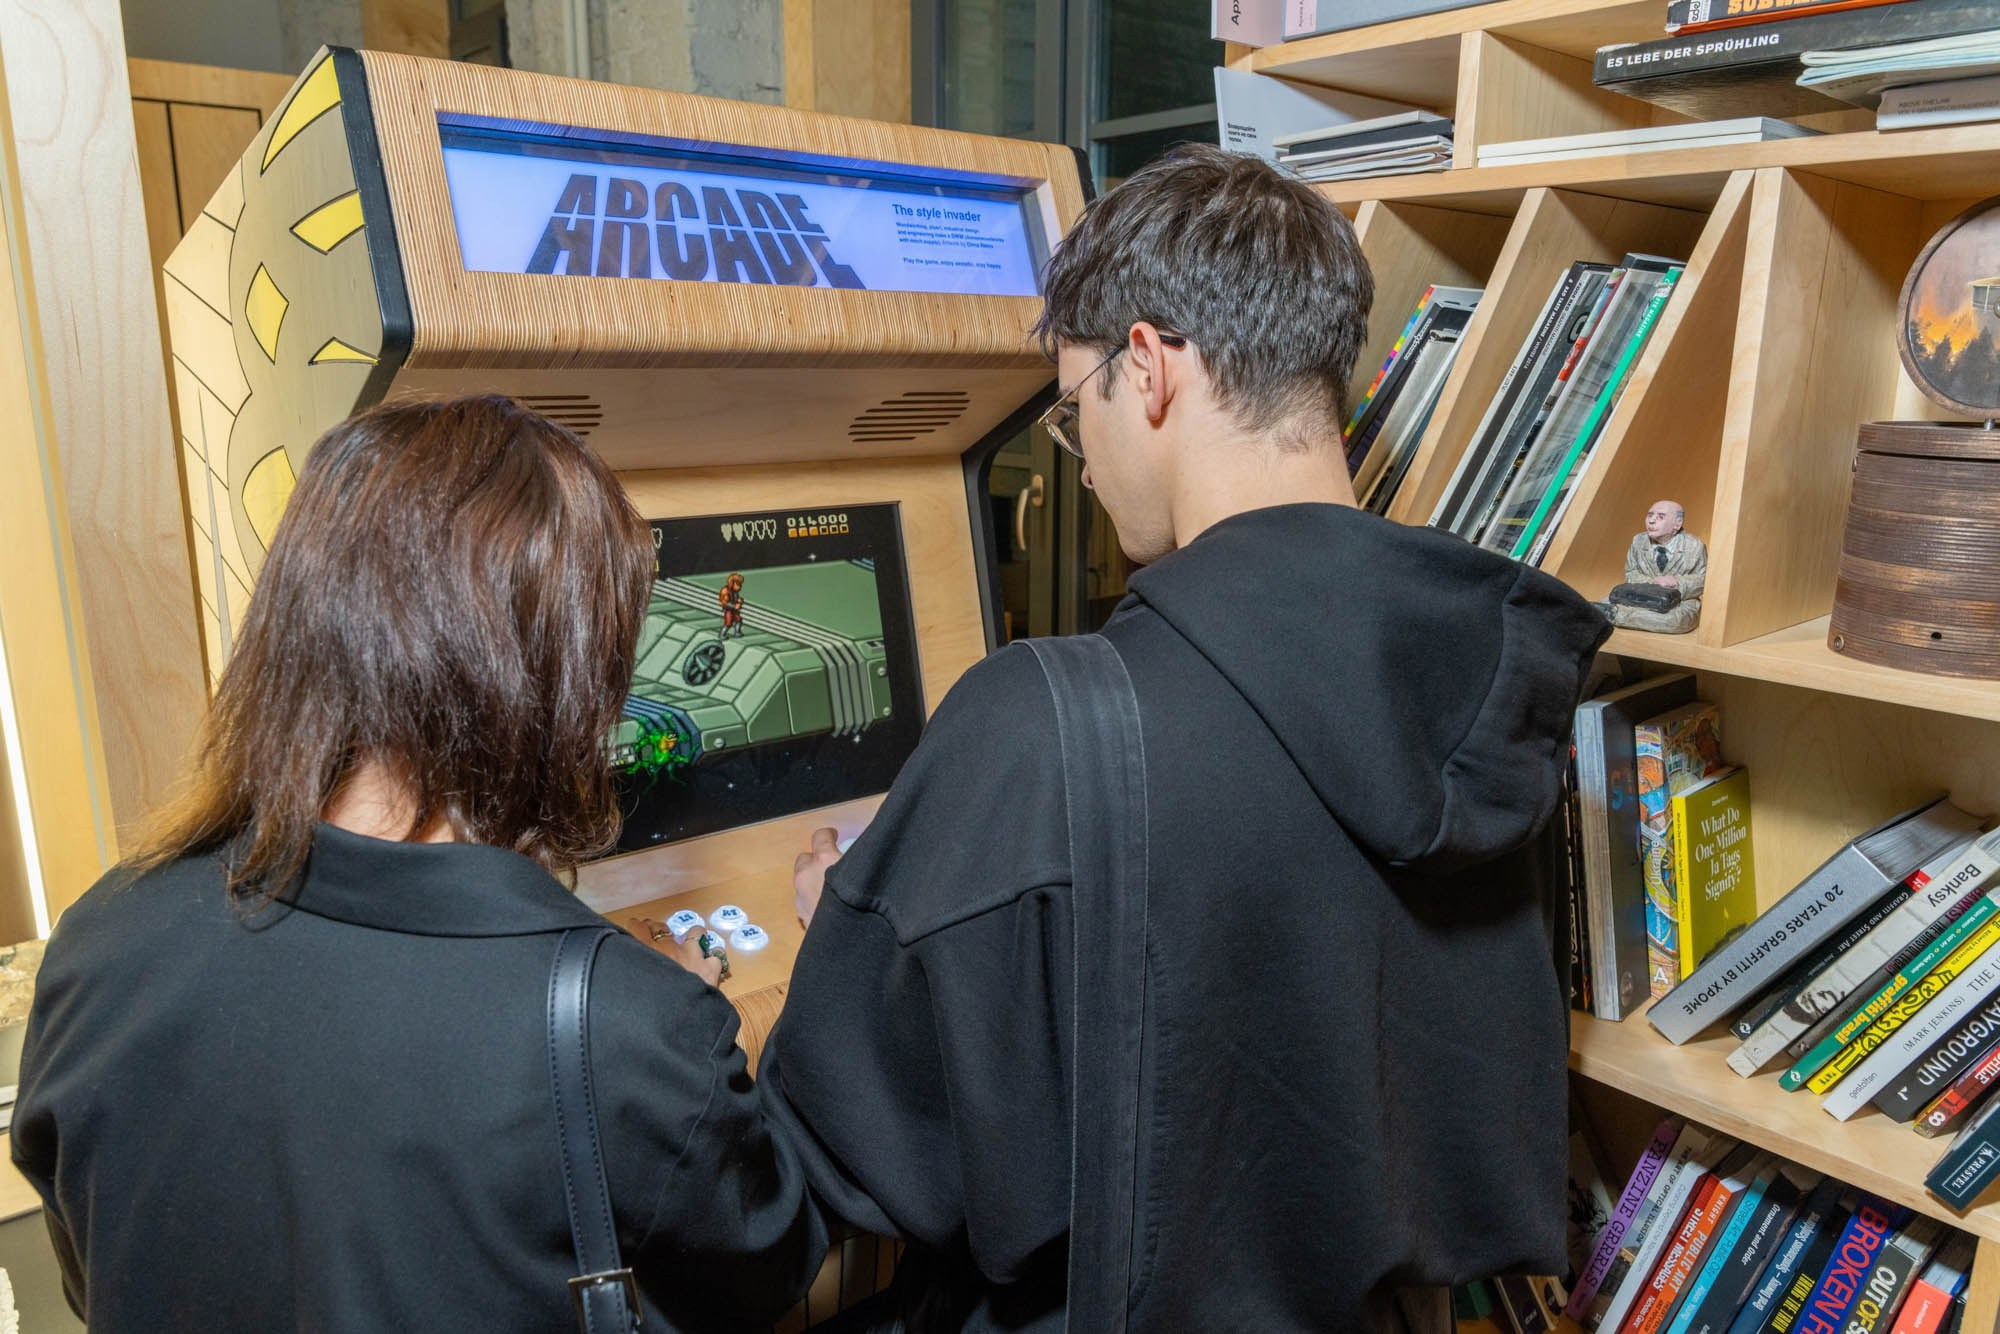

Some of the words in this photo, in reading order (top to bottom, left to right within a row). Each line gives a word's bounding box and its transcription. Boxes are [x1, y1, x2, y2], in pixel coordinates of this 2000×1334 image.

[1606, 57, 1624, 69] ES
[1627, 52, 1660, 66] LEBE
[1664, 47, 1692, 62] DER
[1695, 33, 1780, 55] SPRÜHLING
[892, 203, 914, 217] The
[916, 206, 941, 220] style
[943, 208, 981, 222] invader
[525, 173, 867, 290] ARCADE
[1553, 296, 1563, 311] TASTE
[1539, 311, 1556, 337] MAGAZINE
[787, 513, 848, 526] 014000
[1700, 812, 1727, 838] What
[1726, 807, 1740, 824] Do
[1695, 843, 1714, 863] One
[1716, 827, 1747, 852] Million
[1649, 839, 1662, 884] Ukraine
[1720, 849, 1741, 872] Tags
[1704, 867, 1742, 901] Signify?
[1823, 883, 1844, 903] 20
[1925, 862, 1981, 909] Banksy
[1784, 898, 1826, 935] YEARS
[1881, 890, 1910, 916] GRAFFITI
[1846, 922, 1871, 944] STREET
[1867, 912, 1883, 926] AND
[1929, 918, 1948, 937] THE
[1733, 928, 1788, 975] GRAFFITI
[1836, 939, 1850, 952] ART
[1719, 968, 1737, 985] BY
[1966, 967, 1994, 994] THE
[1681, 980, 1722, 1016] XPOME
[1863, 971, 1911, 1019] graffiti
[1833, 1010, 1870, 1045] brasil
[1901, 1024, 1931, 1053] (MARK
[1927, 993, 1966, 1030] JENKINS)
[1847, 1069, 1878, 1101] gestalten
[1617, 1136, 1668, 1218] FANZINE
[1666, 1172, 1678, 1185] OF
[1672, 1159, 1684, 1173] ART
[1950, 1154, 1986, 1191] PRESTEL
[1650, 1183, 1672, 1215] OPTICAL
[1704, 1193, 1727, 1224] KNIGHT
[1736, 1198, 1757, 1224] Street
[1634, 1212, 1656, 1244] ILLUSION
[1679, 1206, 1705, 1243] STREET
[1757, 1202, 1782, 1236] Ornament
[1582, 1218, 1627, 1289] GRRRLS
[1678, 1229, 1708, 1270] PUBLIC
[1713, 1237, 1734, 1263] Public
[1749, 1233, 1763, 1248] and
[1651, 1241, 1684, 1291] MESSAGES
[1703, 1258, 1721, 1278] City
[1739, 1245, 1756, 1266] Order
[1812, 1203, 1890, 1320] BROKEN
[1666, 1267, 1687, 1293] ART
[1759, 1275, 1782, 1299] Downey
[1790, 1272, 1815, 1301] TAKING
[1751, 1292, 1770, 1311] Brad
[1782, 1295, 1801, 1314] THE
[1770, 1307, 1793, 1334] TRAIN
